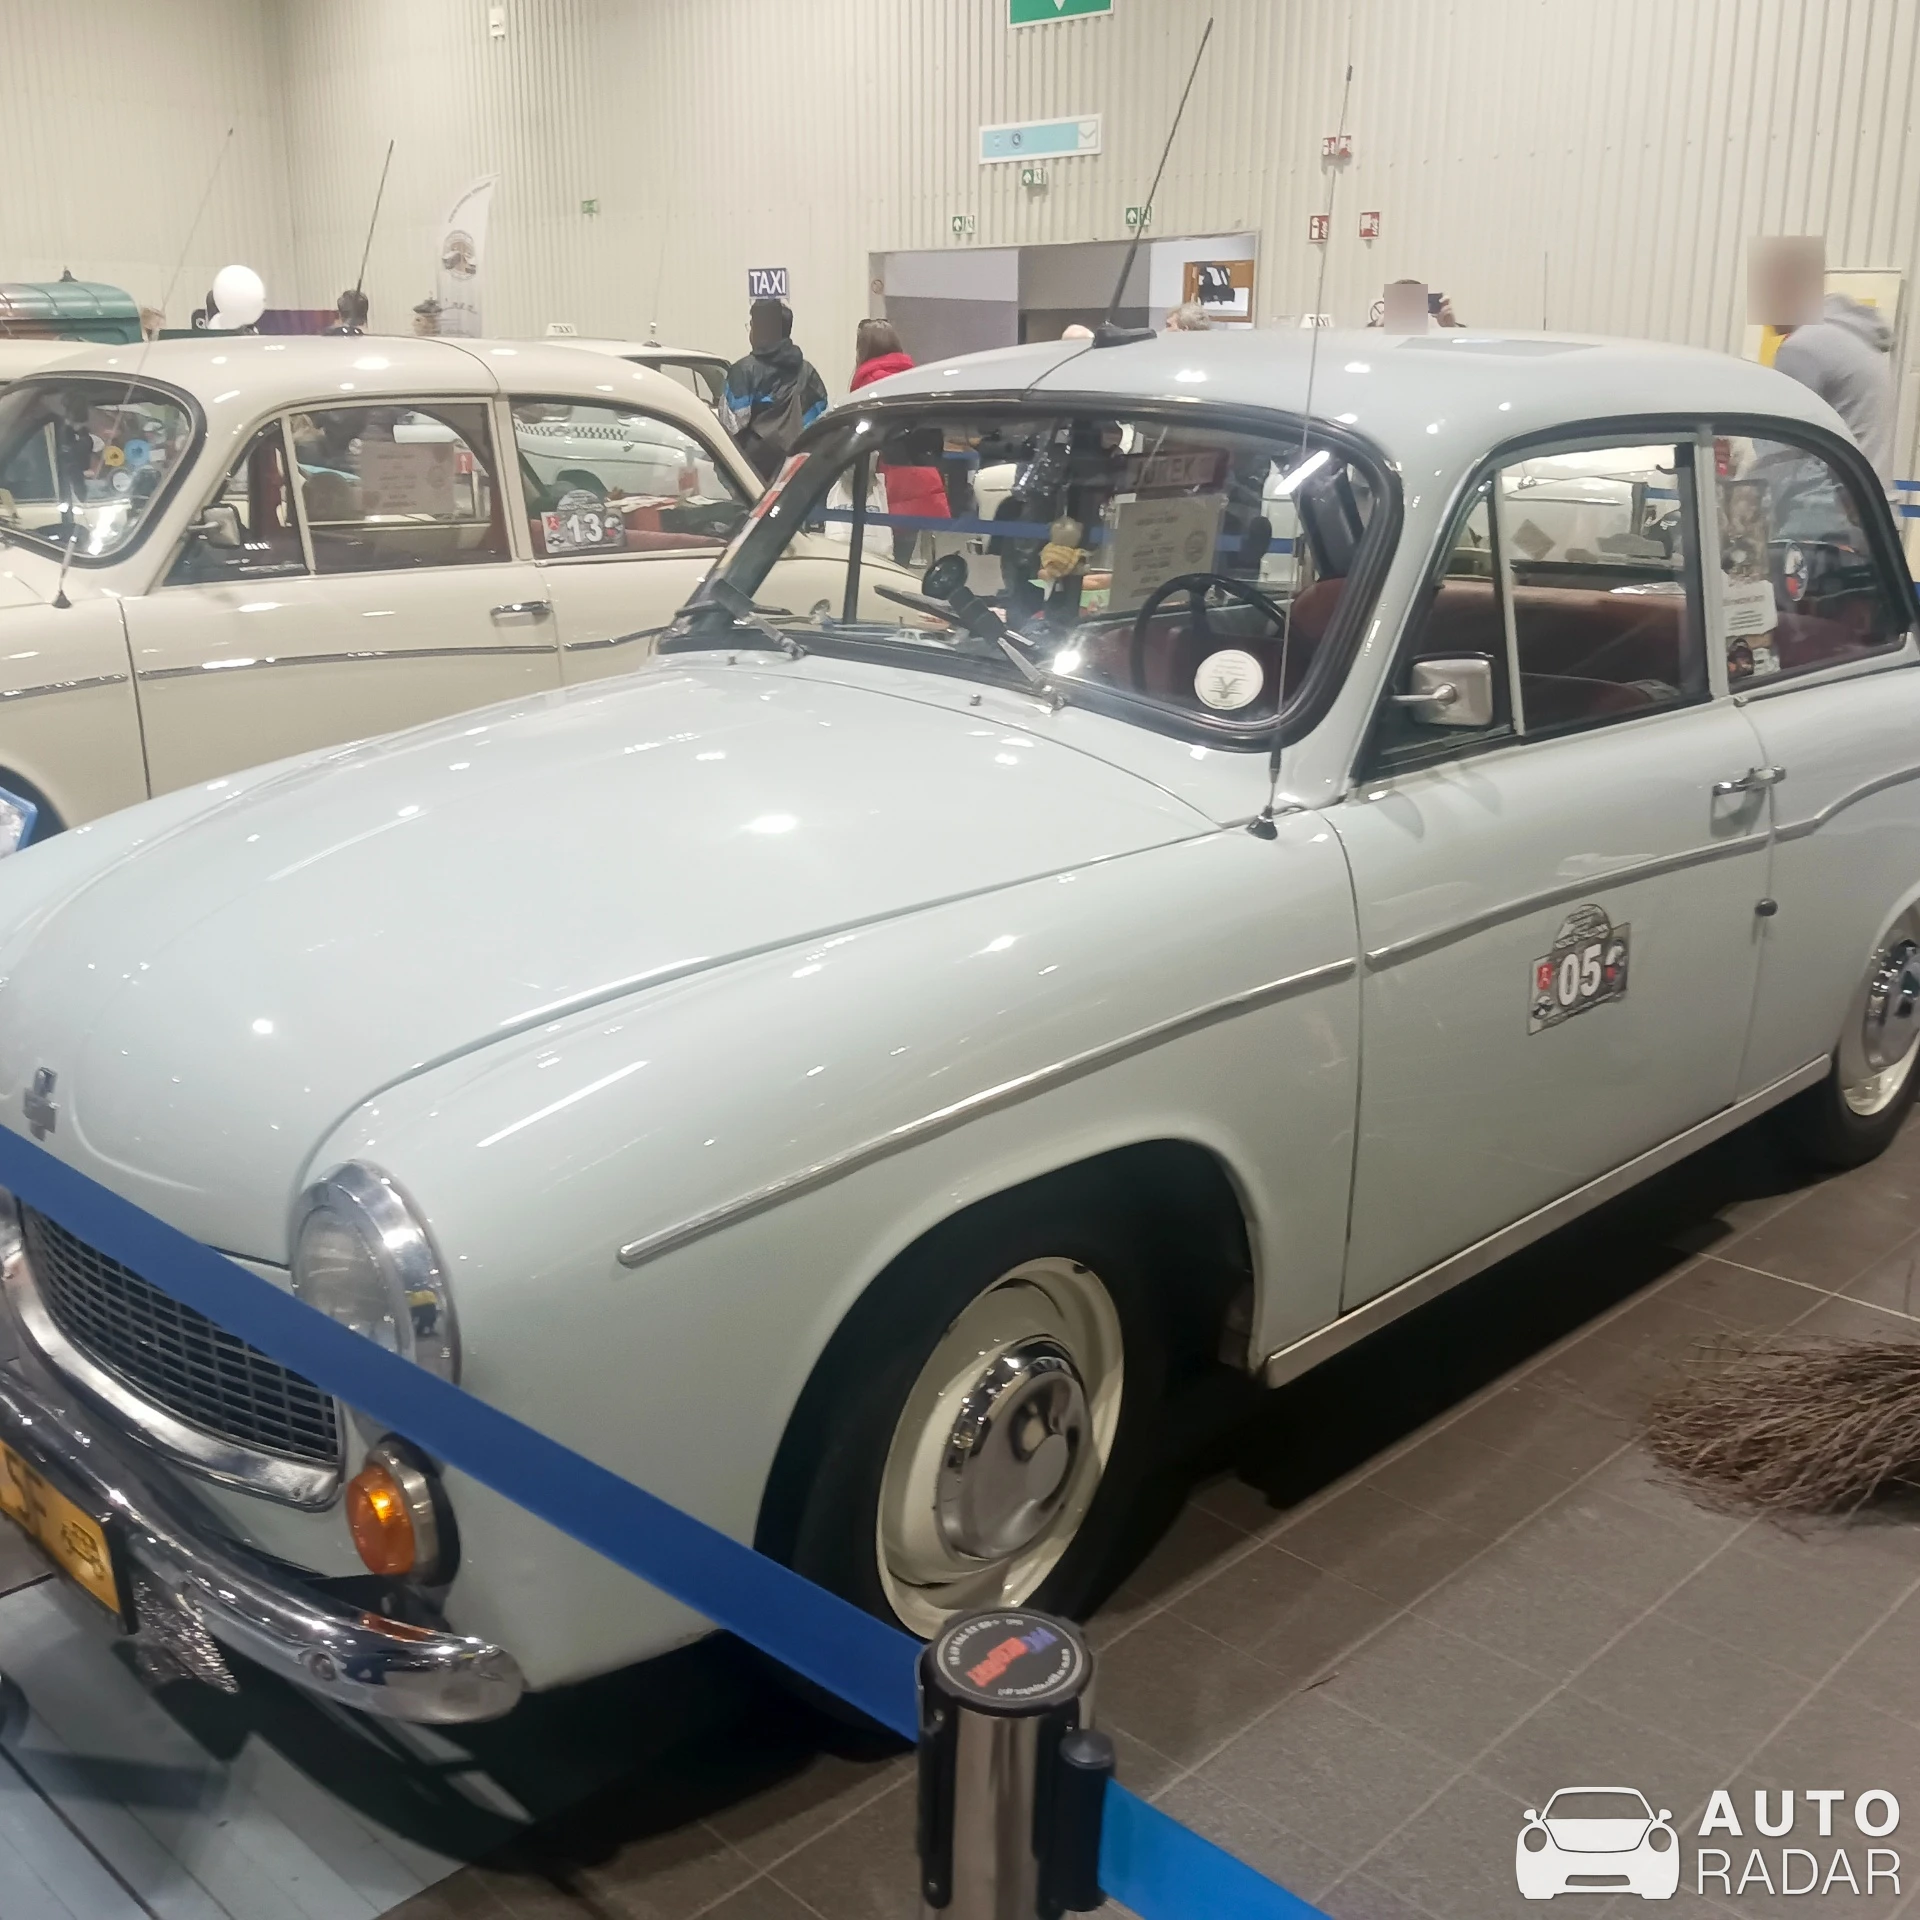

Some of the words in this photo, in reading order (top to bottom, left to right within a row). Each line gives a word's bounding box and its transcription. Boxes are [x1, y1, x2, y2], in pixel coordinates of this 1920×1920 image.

[749, 270, 786, 295] TAXI
[567, 513, 603, 543] 13
[1558, 943, 1602, 1006] 05
